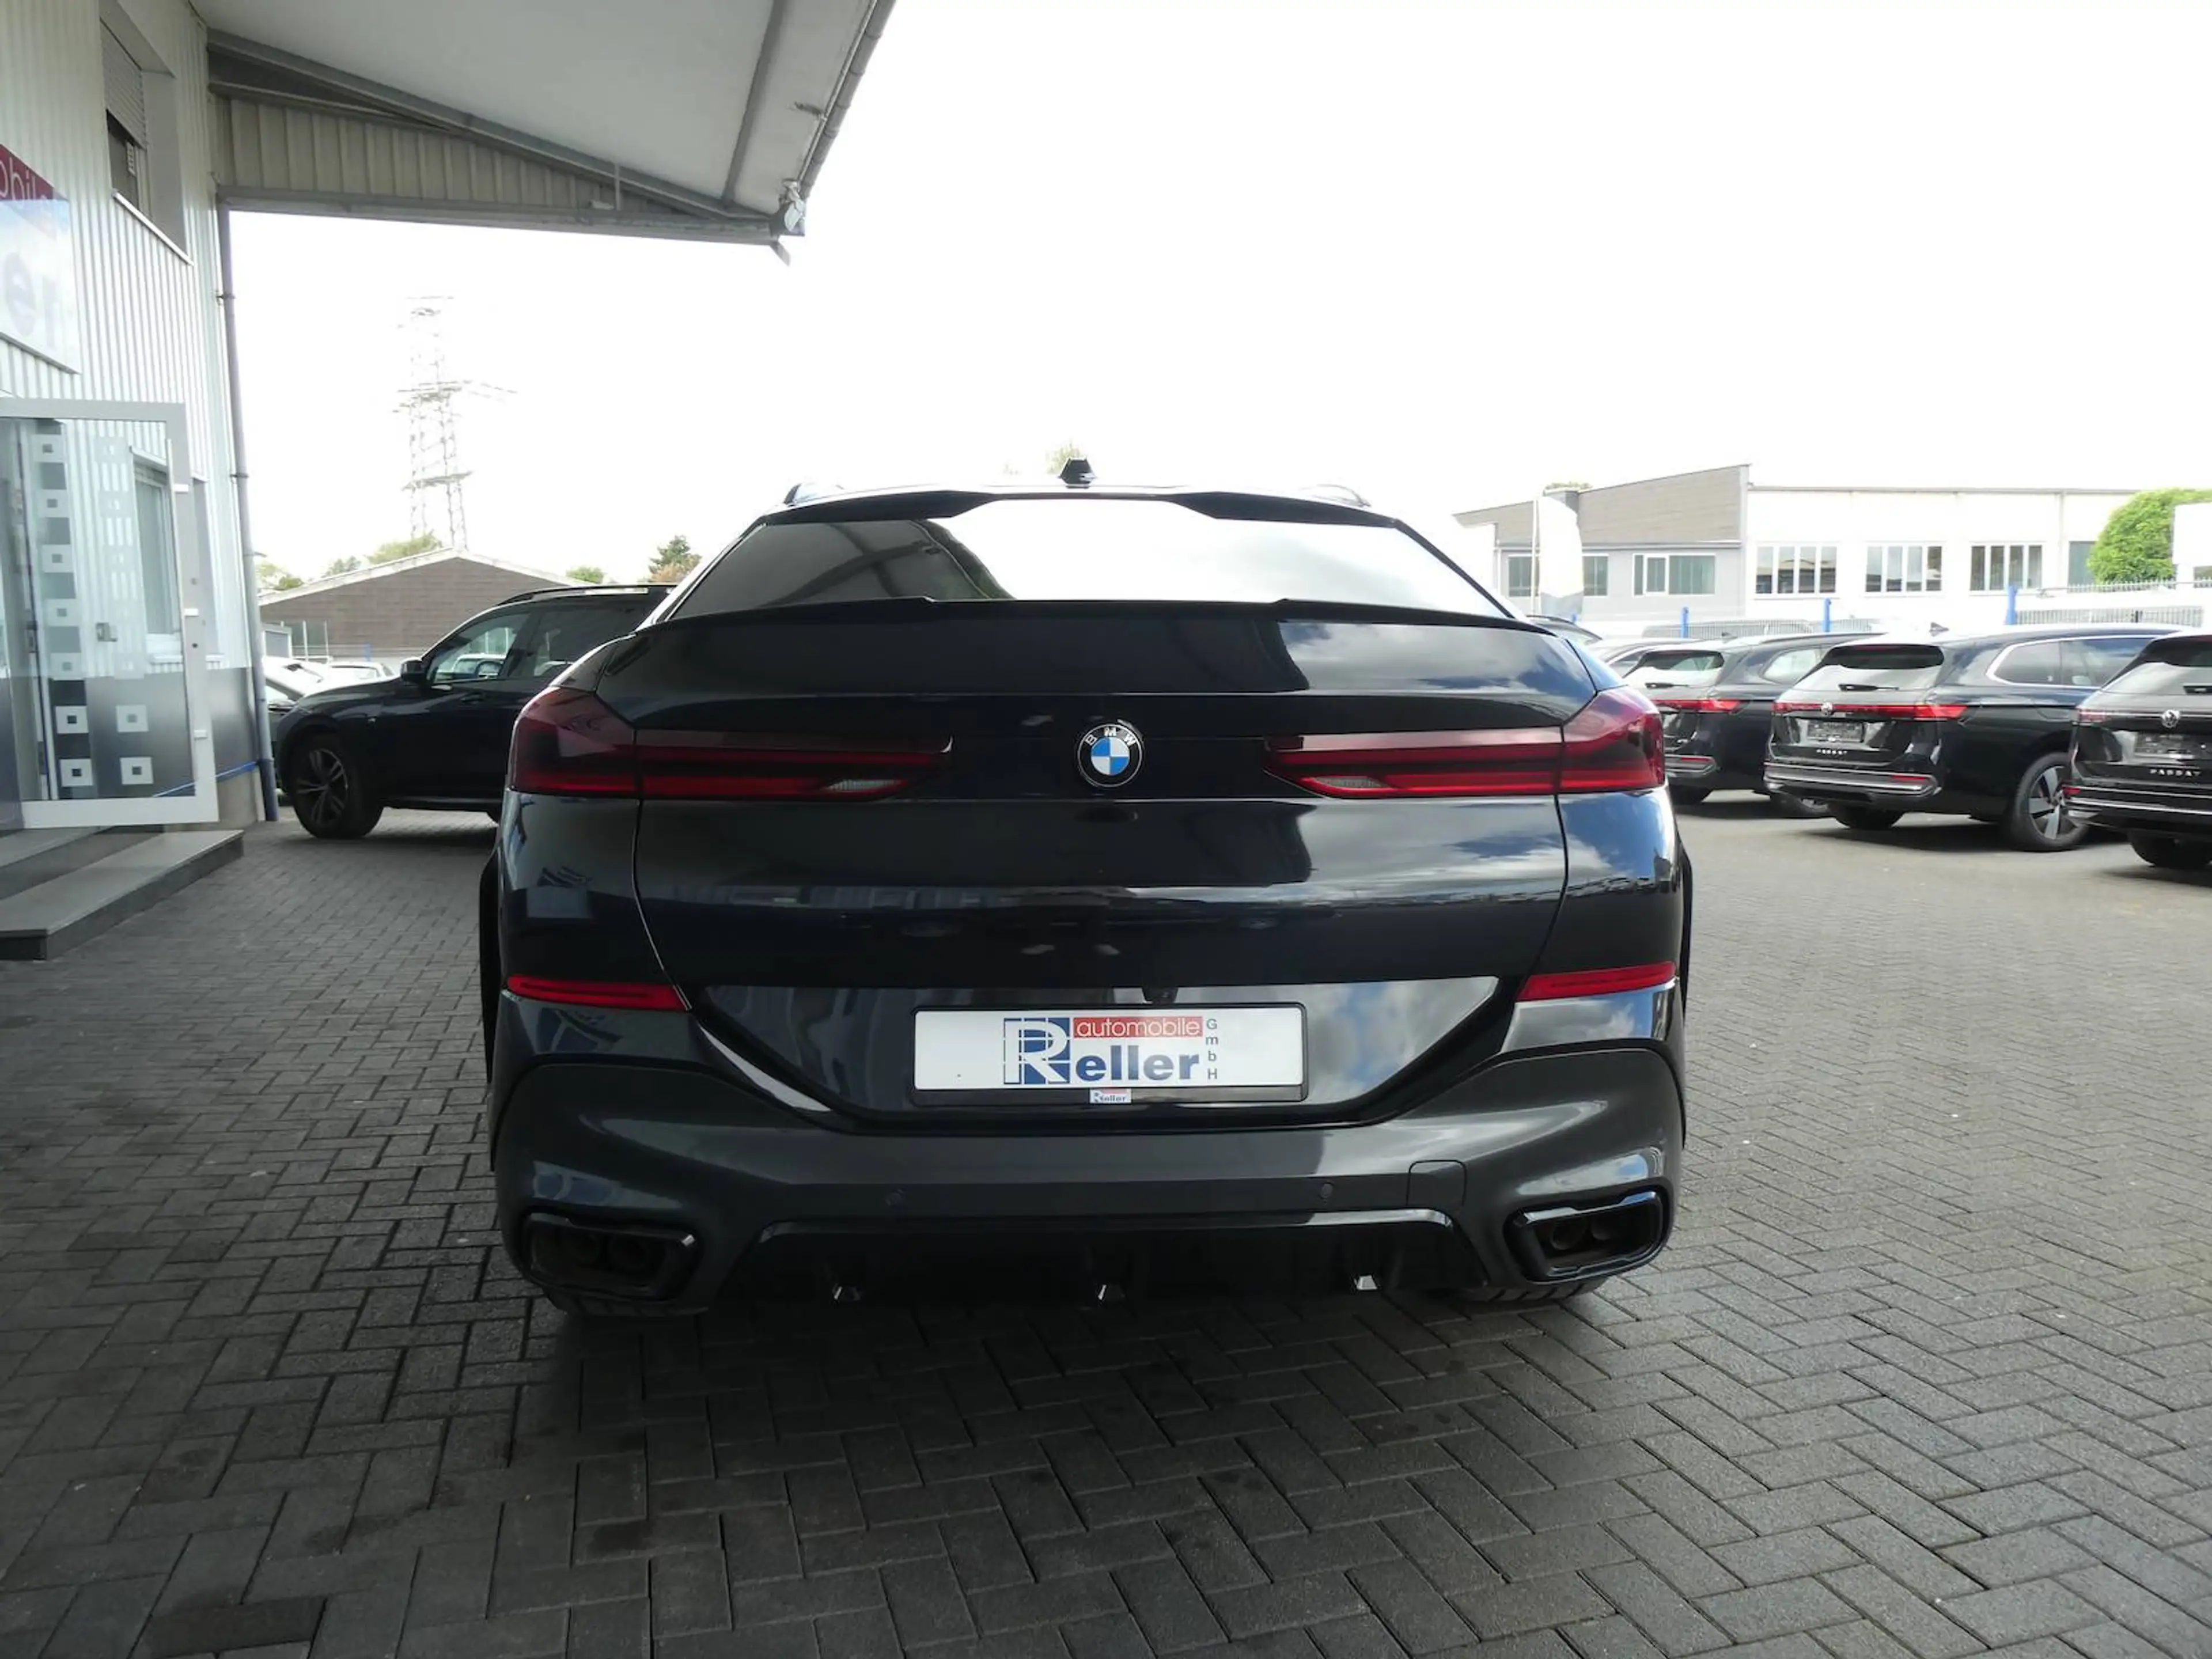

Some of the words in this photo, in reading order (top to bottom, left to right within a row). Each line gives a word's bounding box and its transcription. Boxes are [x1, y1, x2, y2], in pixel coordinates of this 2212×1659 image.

[1085, 727, 1136, 746] BMW
[1076, 1018, 1200, 1037] automobile
[1004, 1018, 1199, 1084] Reller
[1206, 1018, 1218, 1080] GmbH
